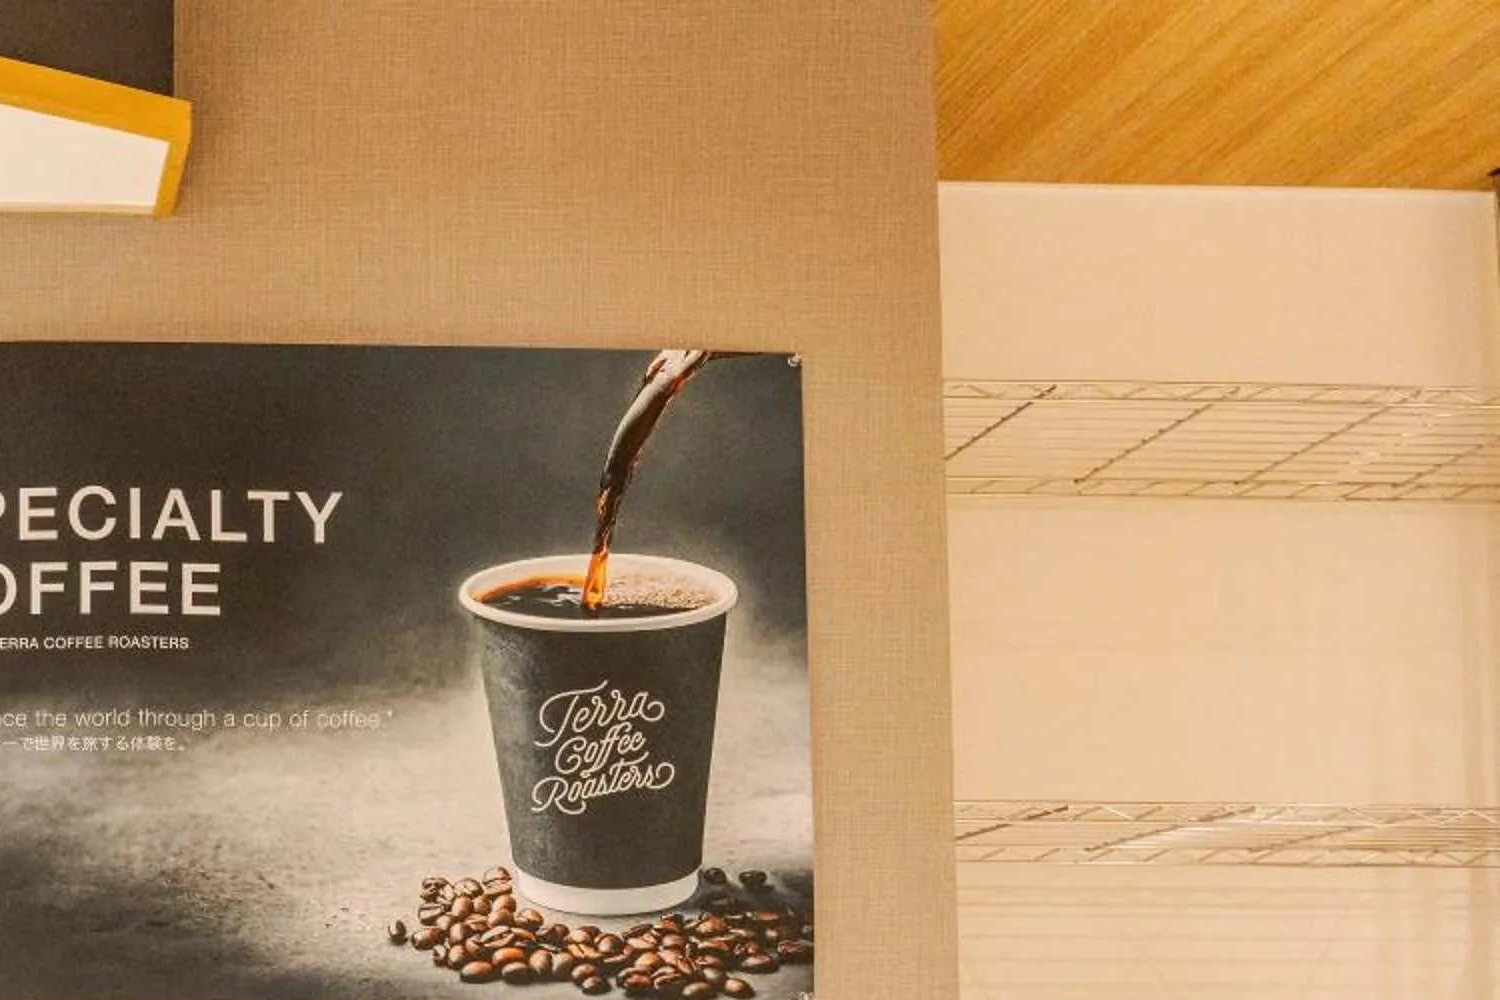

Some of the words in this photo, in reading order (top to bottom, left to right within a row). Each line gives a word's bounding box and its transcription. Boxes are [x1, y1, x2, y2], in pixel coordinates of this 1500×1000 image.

[43, 636, 104, 649] COFFEE
[108, 635, 190, 649] ROASTERS
[35, 707, 68, 727] the
[75, 707, 131, 727] world
[138, 708, 216, 731] through
[223, 712, 236, 728] a
[242, 713, 282, 732] cup
[288, 709, 309, 728] of
[534, 679, 665, 747] Terra
[555, 721, 647, 776] Coffee
[531, 751, 675, 815] Roasters
